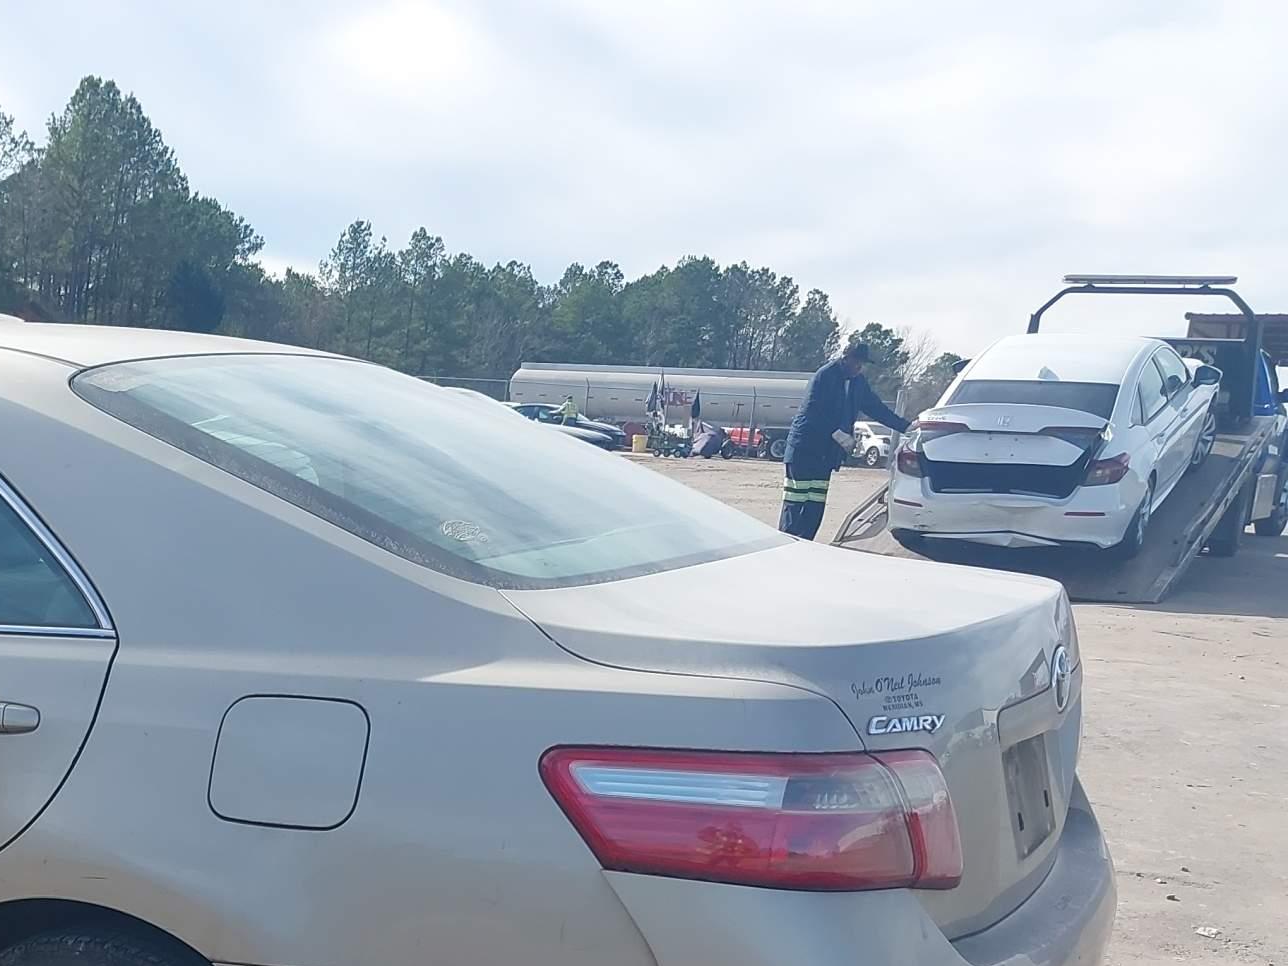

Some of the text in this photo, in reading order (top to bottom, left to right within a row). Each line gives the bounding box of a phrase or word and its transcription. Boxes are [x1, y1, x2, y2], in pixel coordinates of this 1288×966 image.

[851, 680, 875, 700] John
[907, 672, 942, 693] Johnson
[892, 693, 919, 703] TOYOTA
[867, 714, 946, 735] CAMRY
